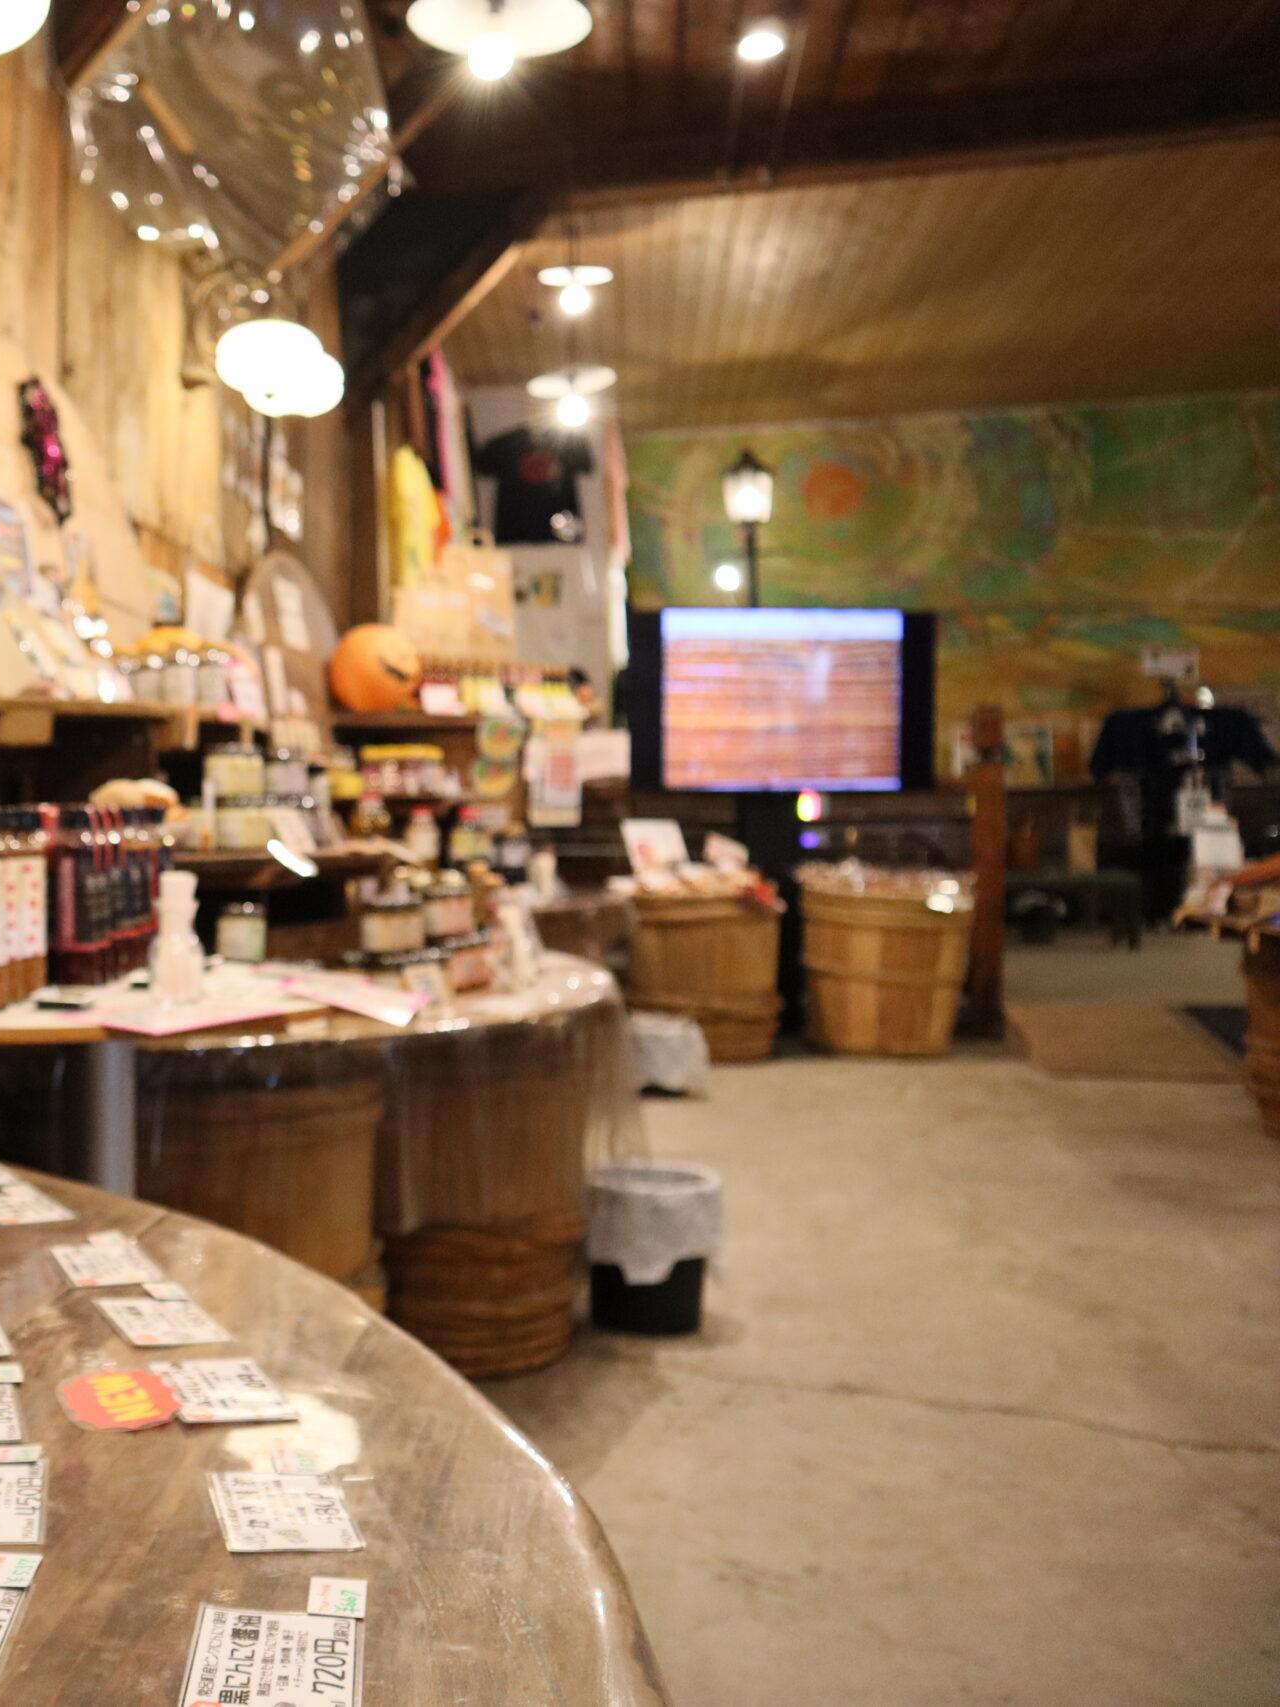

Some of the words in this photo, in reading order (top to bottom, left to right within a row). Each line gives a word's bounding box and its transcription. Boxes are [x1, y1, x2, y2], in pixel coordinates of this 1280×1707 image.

[88, 1375, 161, 1423] NEW
[217, 1614, 263, 1705] 黒にんにく醤油
[310, 1638, 350, 1694] 720円
